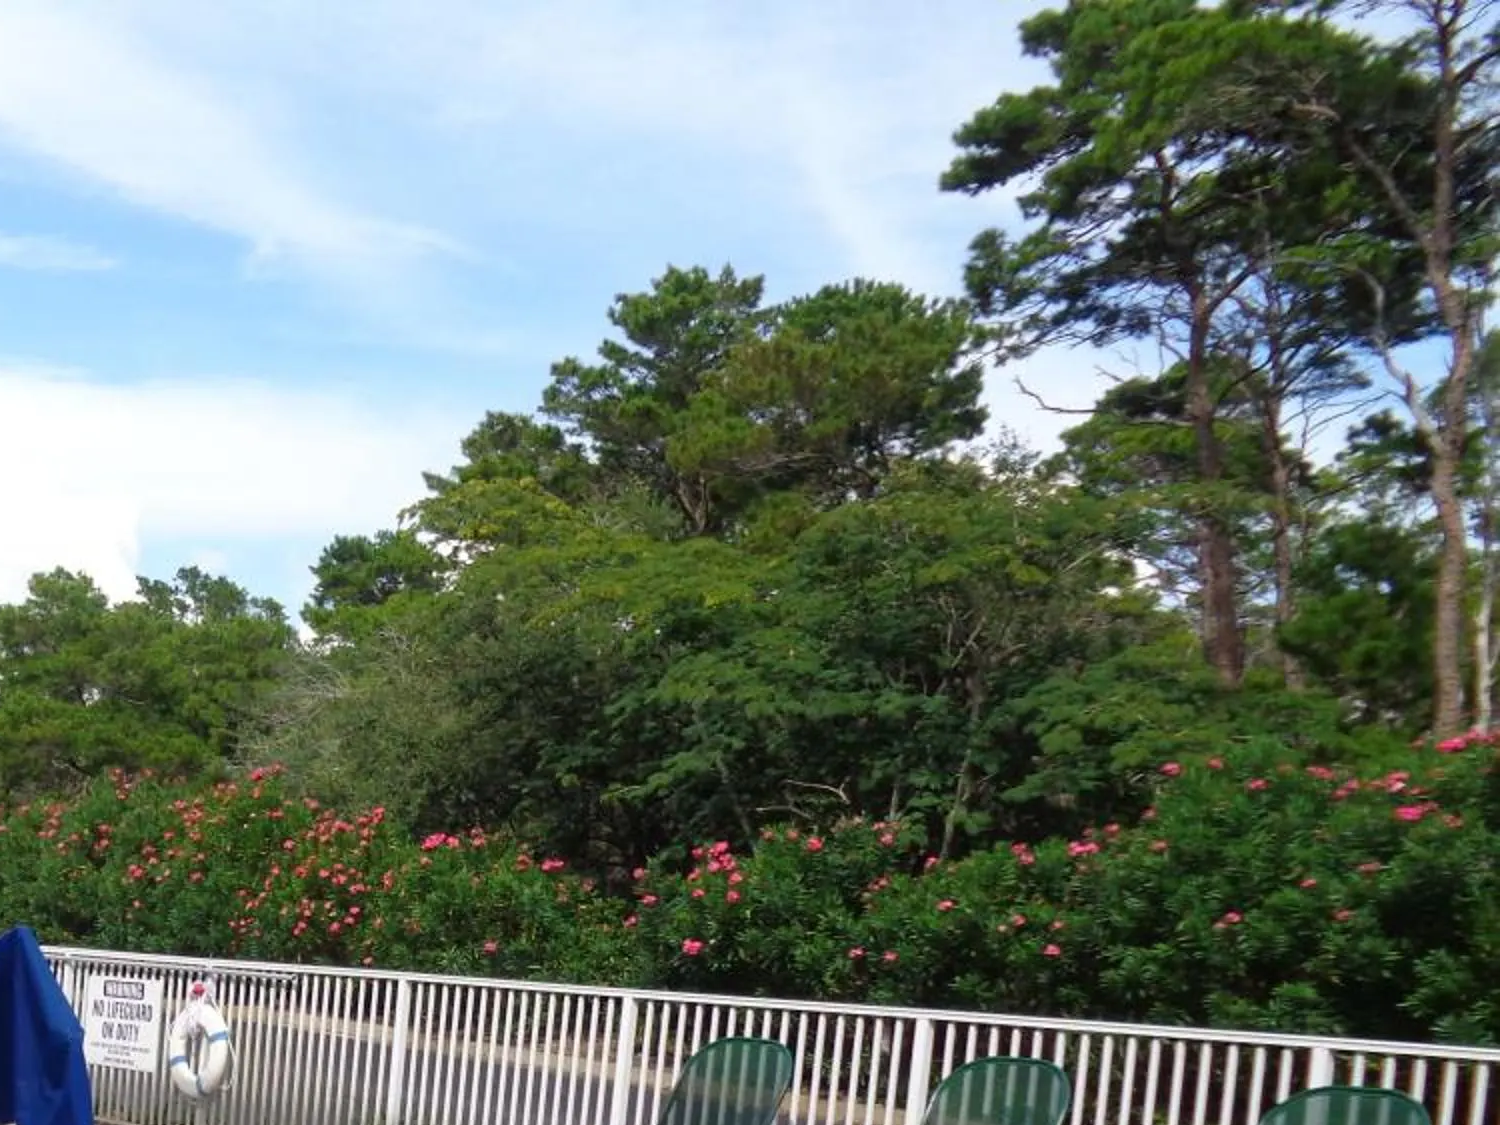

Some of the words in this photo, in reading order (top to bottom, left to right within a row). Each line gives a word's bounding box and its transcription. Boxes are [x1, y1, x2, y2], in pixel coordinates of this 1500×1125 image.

[92, 999, 104, 1017] NO
[107, 1000, 152, 1022] LIFEGUARD
[102, 1021, 114, 1039] ON
[116, 1023, 140, 1041] DUTY
